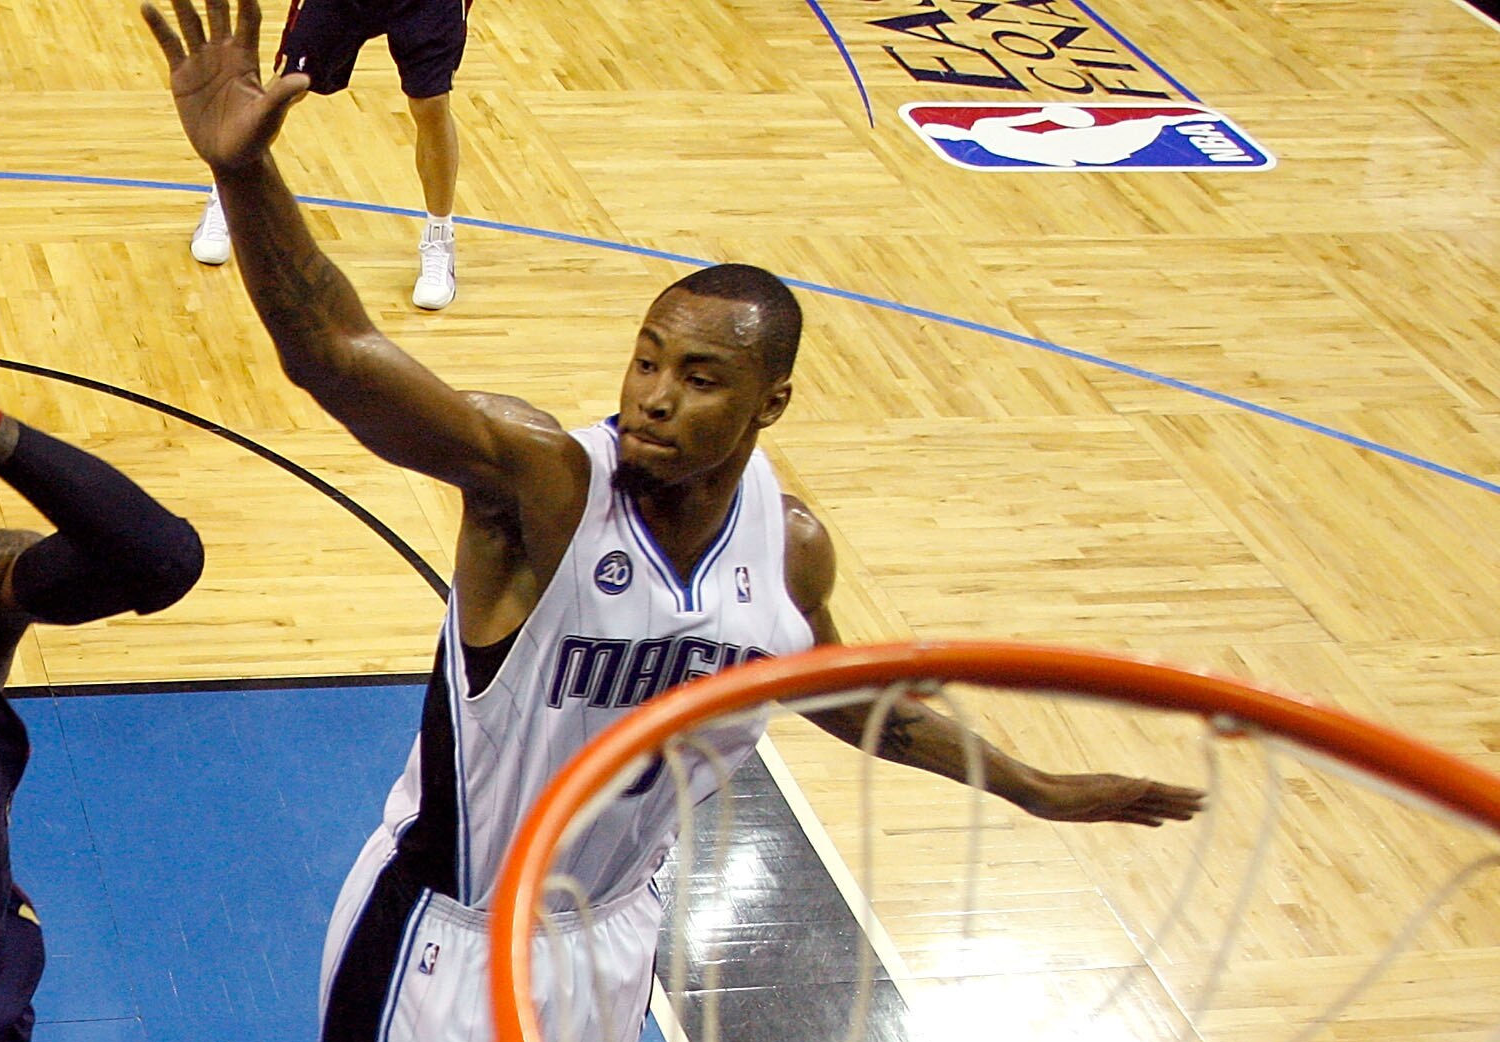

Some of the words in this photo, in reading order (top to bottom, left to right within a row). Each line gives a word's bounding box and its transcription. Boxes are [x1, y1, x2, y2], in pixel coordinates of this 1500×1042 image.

[1175, 123, 1254, 162] NBA
[597, 561, 630, 586] 20
[548, 635, 777, 709] MAG
